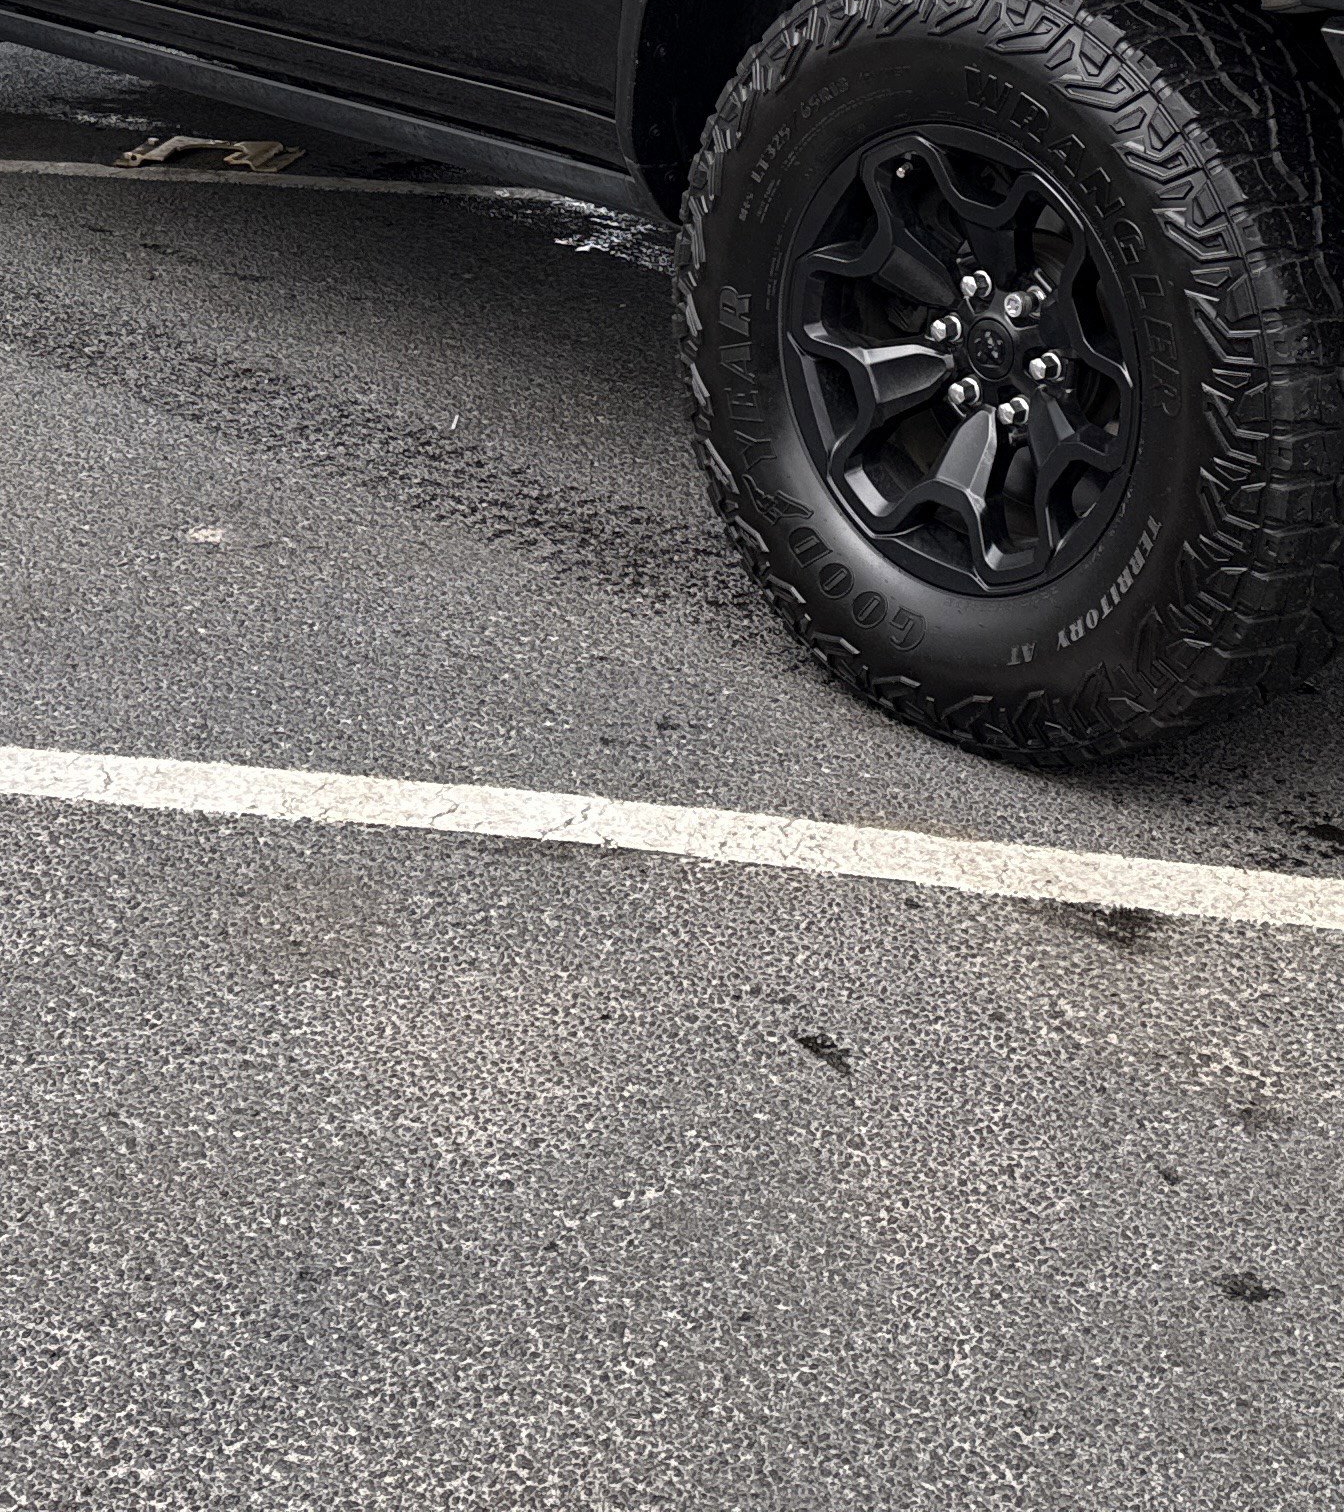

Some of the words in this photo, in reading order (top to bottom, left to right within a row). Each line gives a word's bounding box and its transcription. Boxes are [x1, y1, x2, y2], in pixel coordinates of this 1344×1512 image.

[964, 64, 1183, 418] WRANGLER
[1057, 515, 1164, 652] TERRITORY
[1006, 641, 1038, 666] AT
